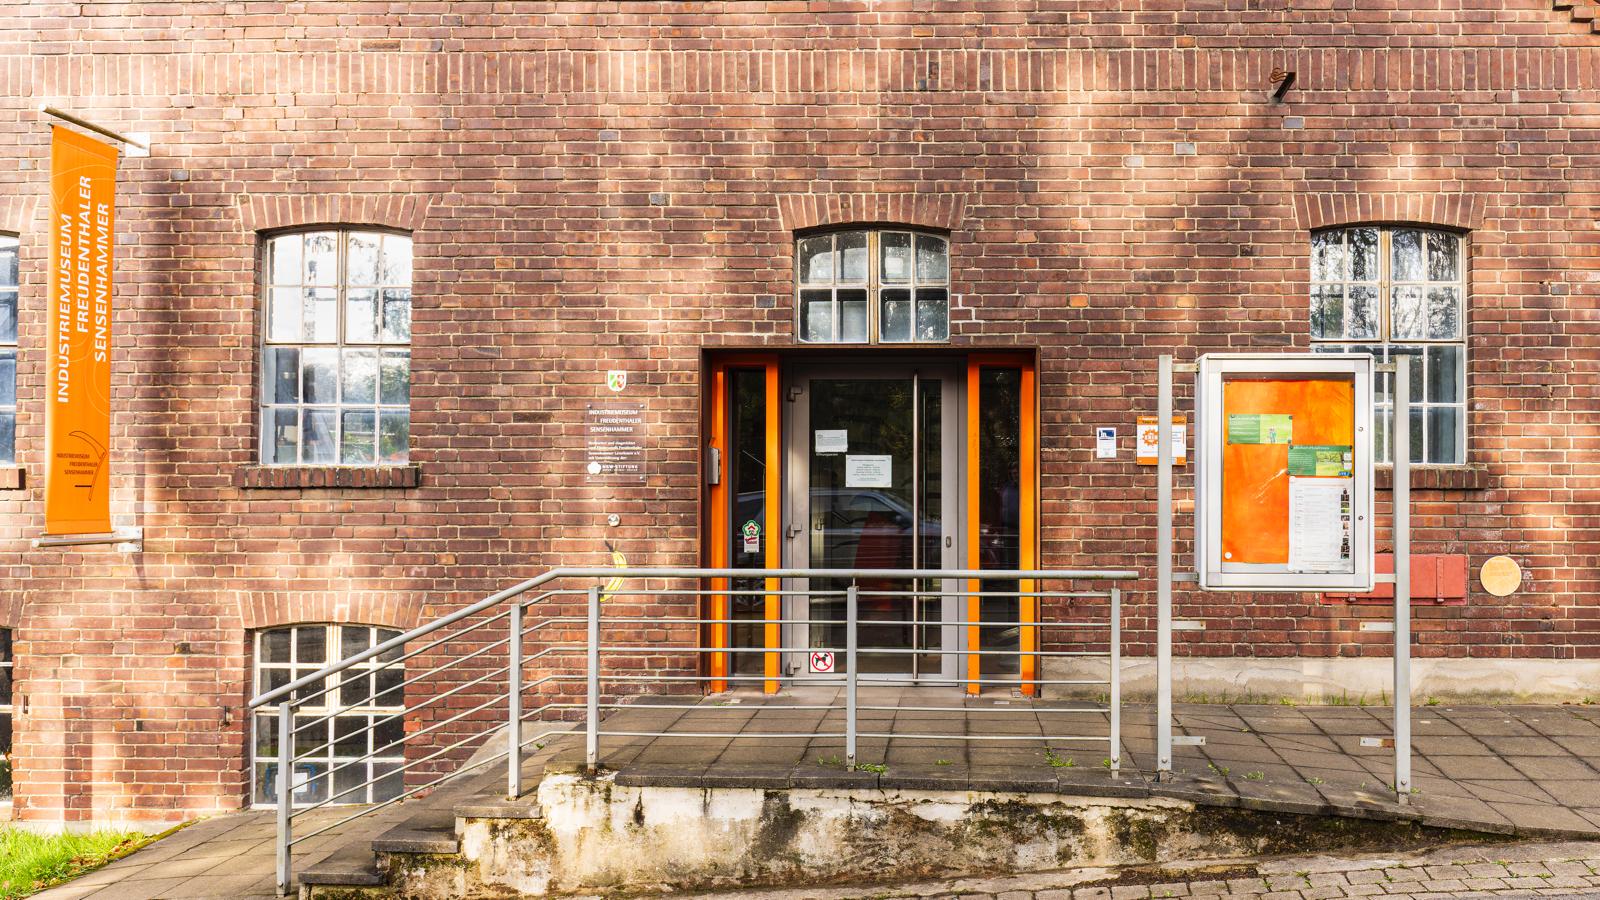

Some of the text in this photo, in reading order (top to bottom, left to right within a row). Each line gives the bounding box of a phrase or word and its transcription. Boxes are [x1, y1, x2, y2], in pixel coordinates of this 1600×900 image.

[57, 213, 72, 403] INDUSTRIEMUSEUM
[77, 175, 91, 333] FREUDENTHALER
[95, 202, 109, 362] SENSENHAMMER
